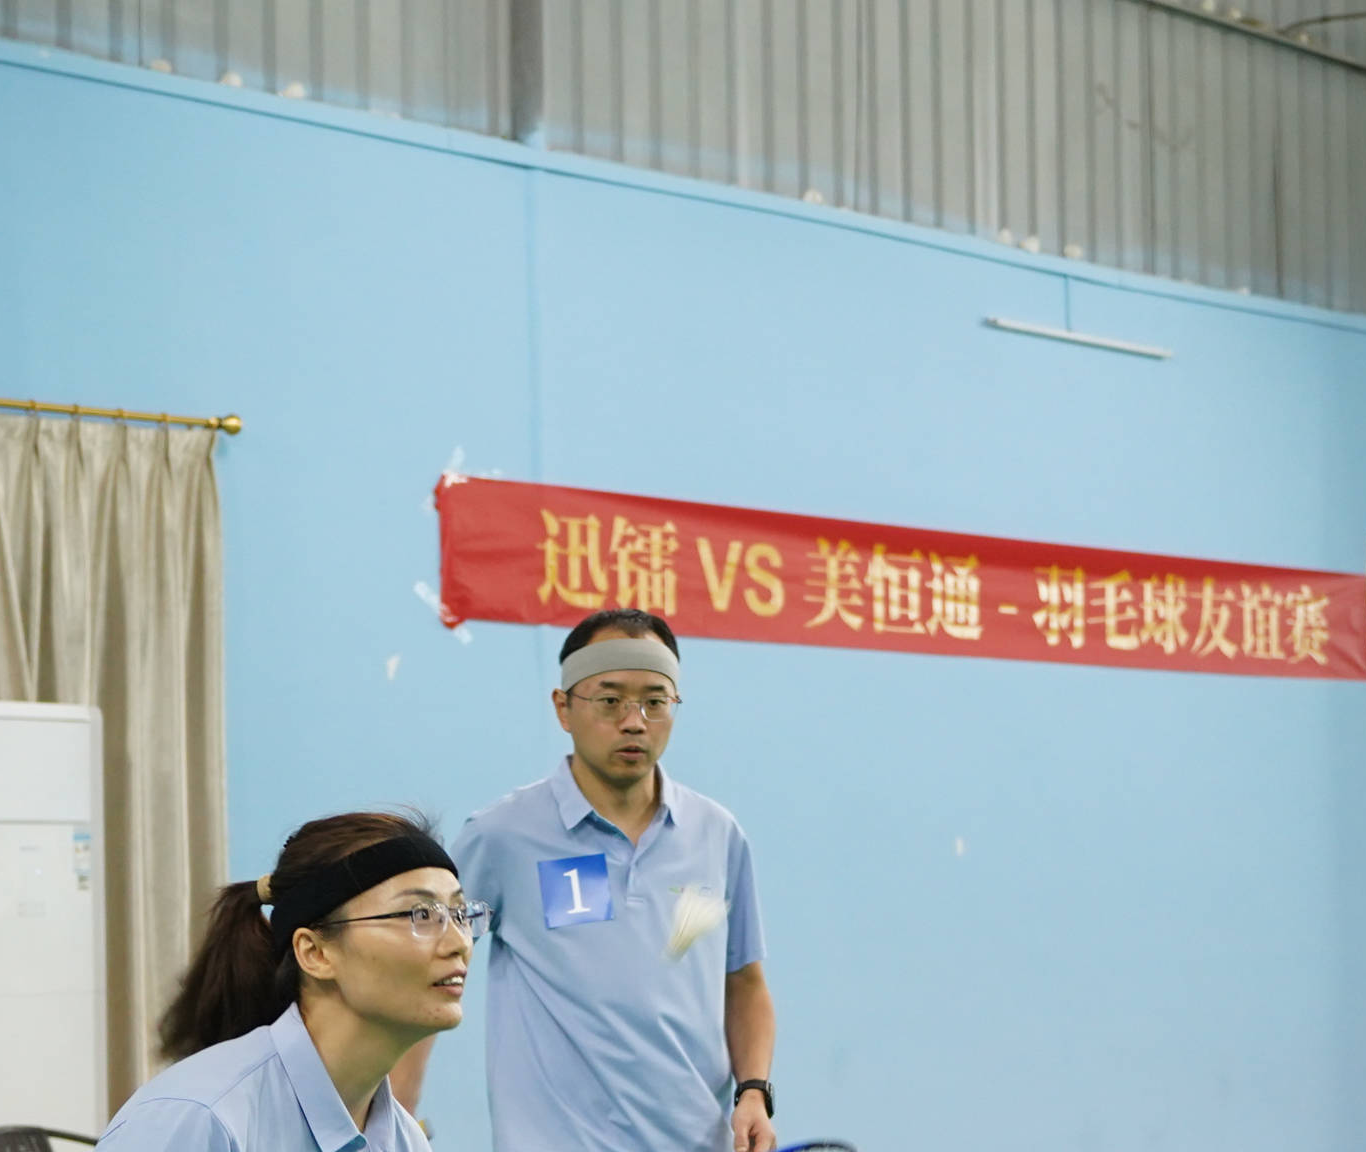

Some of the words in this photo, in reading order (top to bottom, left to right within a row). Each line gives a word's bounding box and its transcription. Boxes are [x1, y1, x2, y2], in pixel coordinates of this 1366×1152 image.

[536, 508, 678, 617] 迅镭
[695, 536, 785, 618] VS
[802, 537, 983, 640] 美恒通
[1032, 565, 1330, 666] 羽毛球友谊赛
[563, 868, 592, 914] 1
